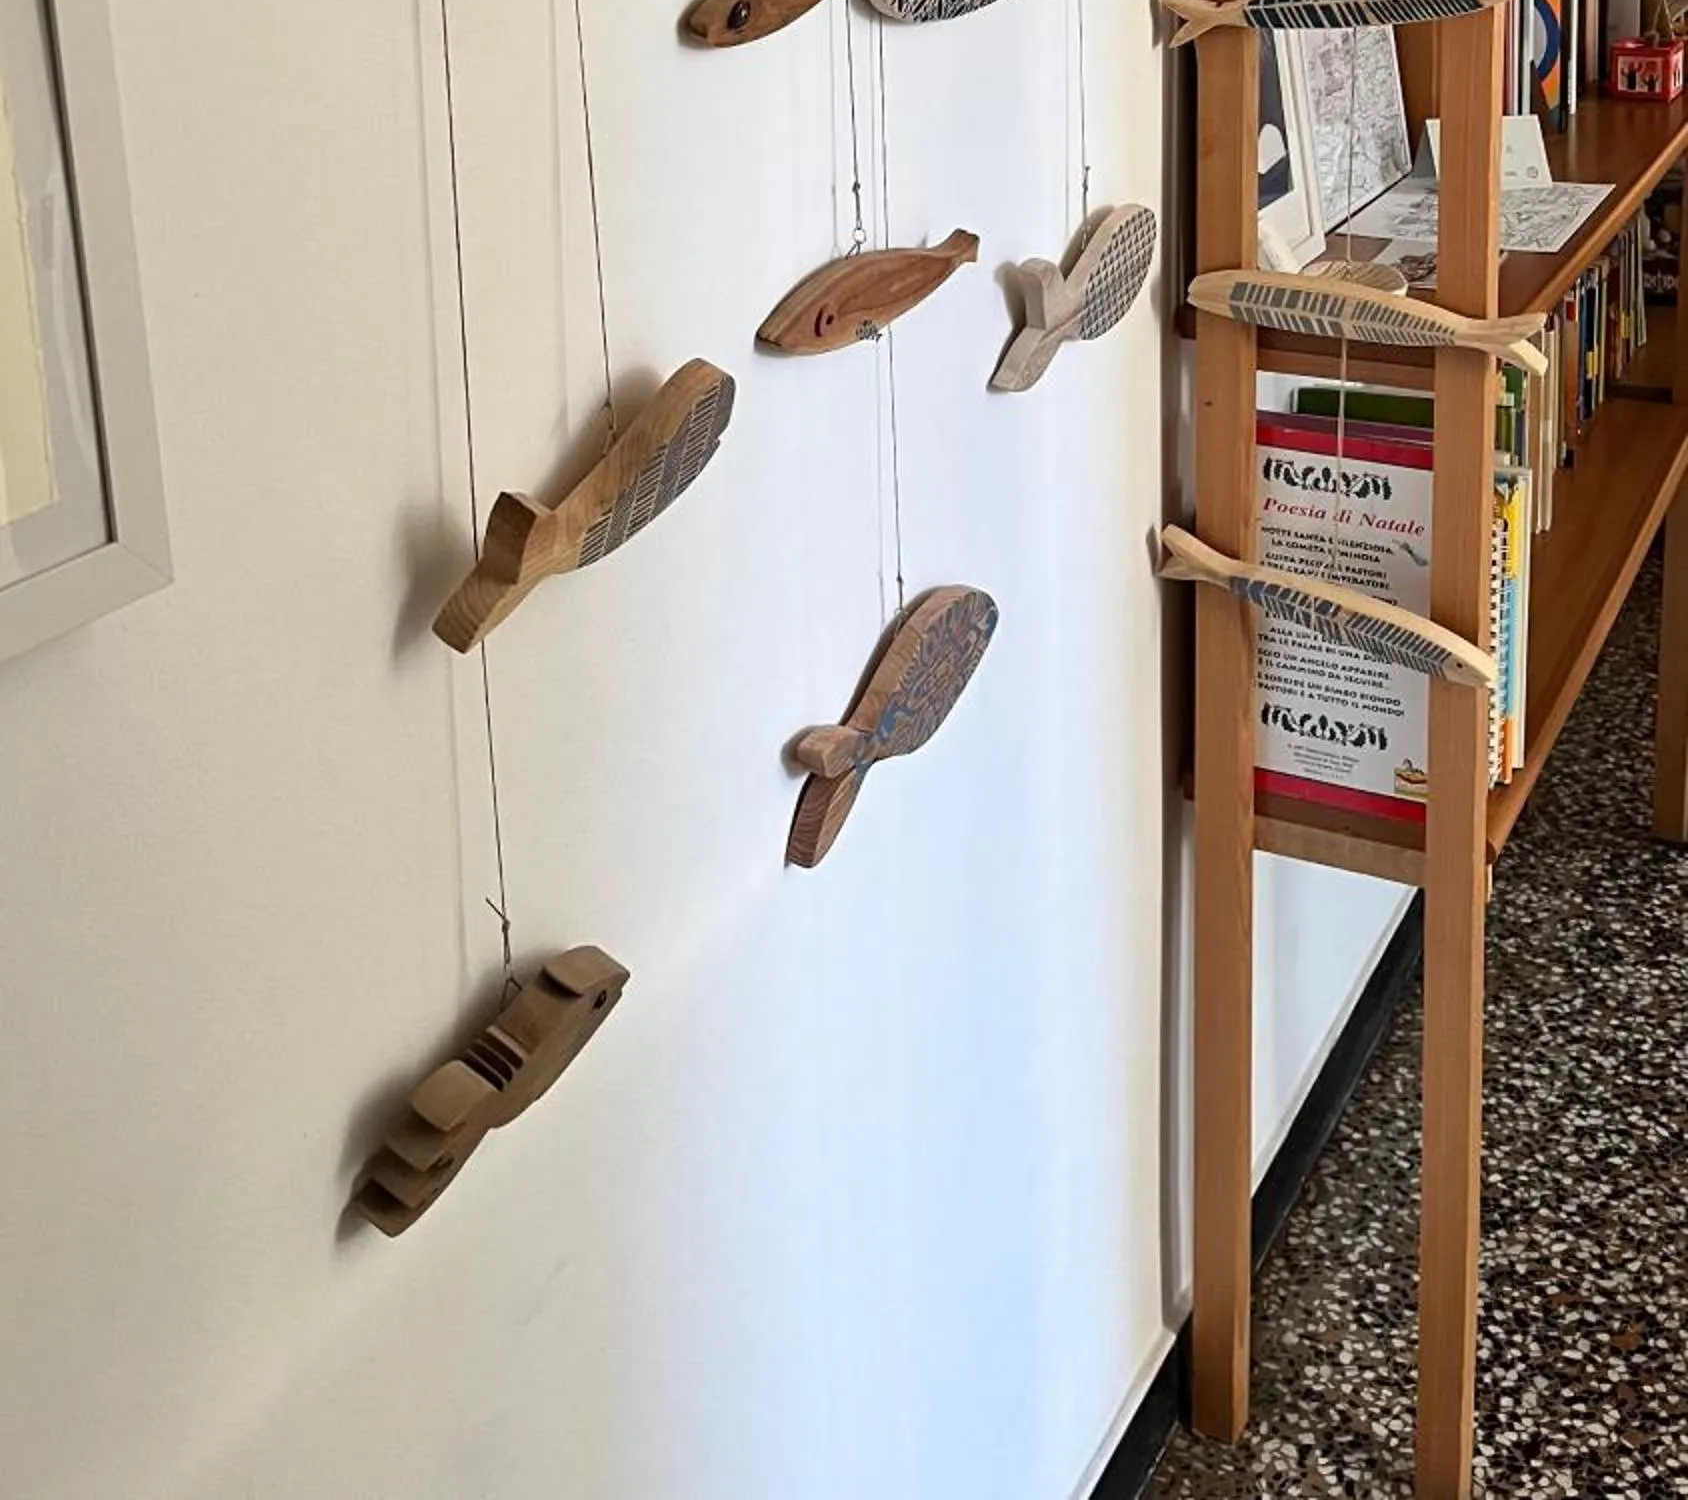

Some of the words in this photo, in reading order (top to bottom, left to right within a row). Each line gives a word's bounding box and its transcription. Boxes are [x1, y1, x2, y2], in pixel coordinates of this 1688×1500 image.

[1263, 497, 1326, 520] Poesia
[1332, 509, 1353, 525] di
[1360, 512, 1425, 537] Natale
[1294, 531, 1327, 543] SANTA
[1271, 538, 1284, 547] LA
[1286, 541, 1326, 554] COMETA
[1334, 548, 1381, 564] MINOSA
[1345, 565, 1388, 580] PASTORI
[1258, 632, 1277, 644] TRA
[1291, 639, 1323, 652] PALME
[1339, 649, 1361, 660] UNA
[1276, 661, 1327, 677] CAMMINO
[1327, 671, 1342, 681] DA
[1283, 652, 1298, 661] UN
[1300, 656, 1338, 671] ANGELO
[1264, 673, 1305, 688] SORRIDE
[1308, 681, 1322, 691] UN
[1324, 685, 1357, 699] BIMBO
[1360, 693, 1401, 707] BIONDO
[1316, 692, 1349, 707] TUTTO
